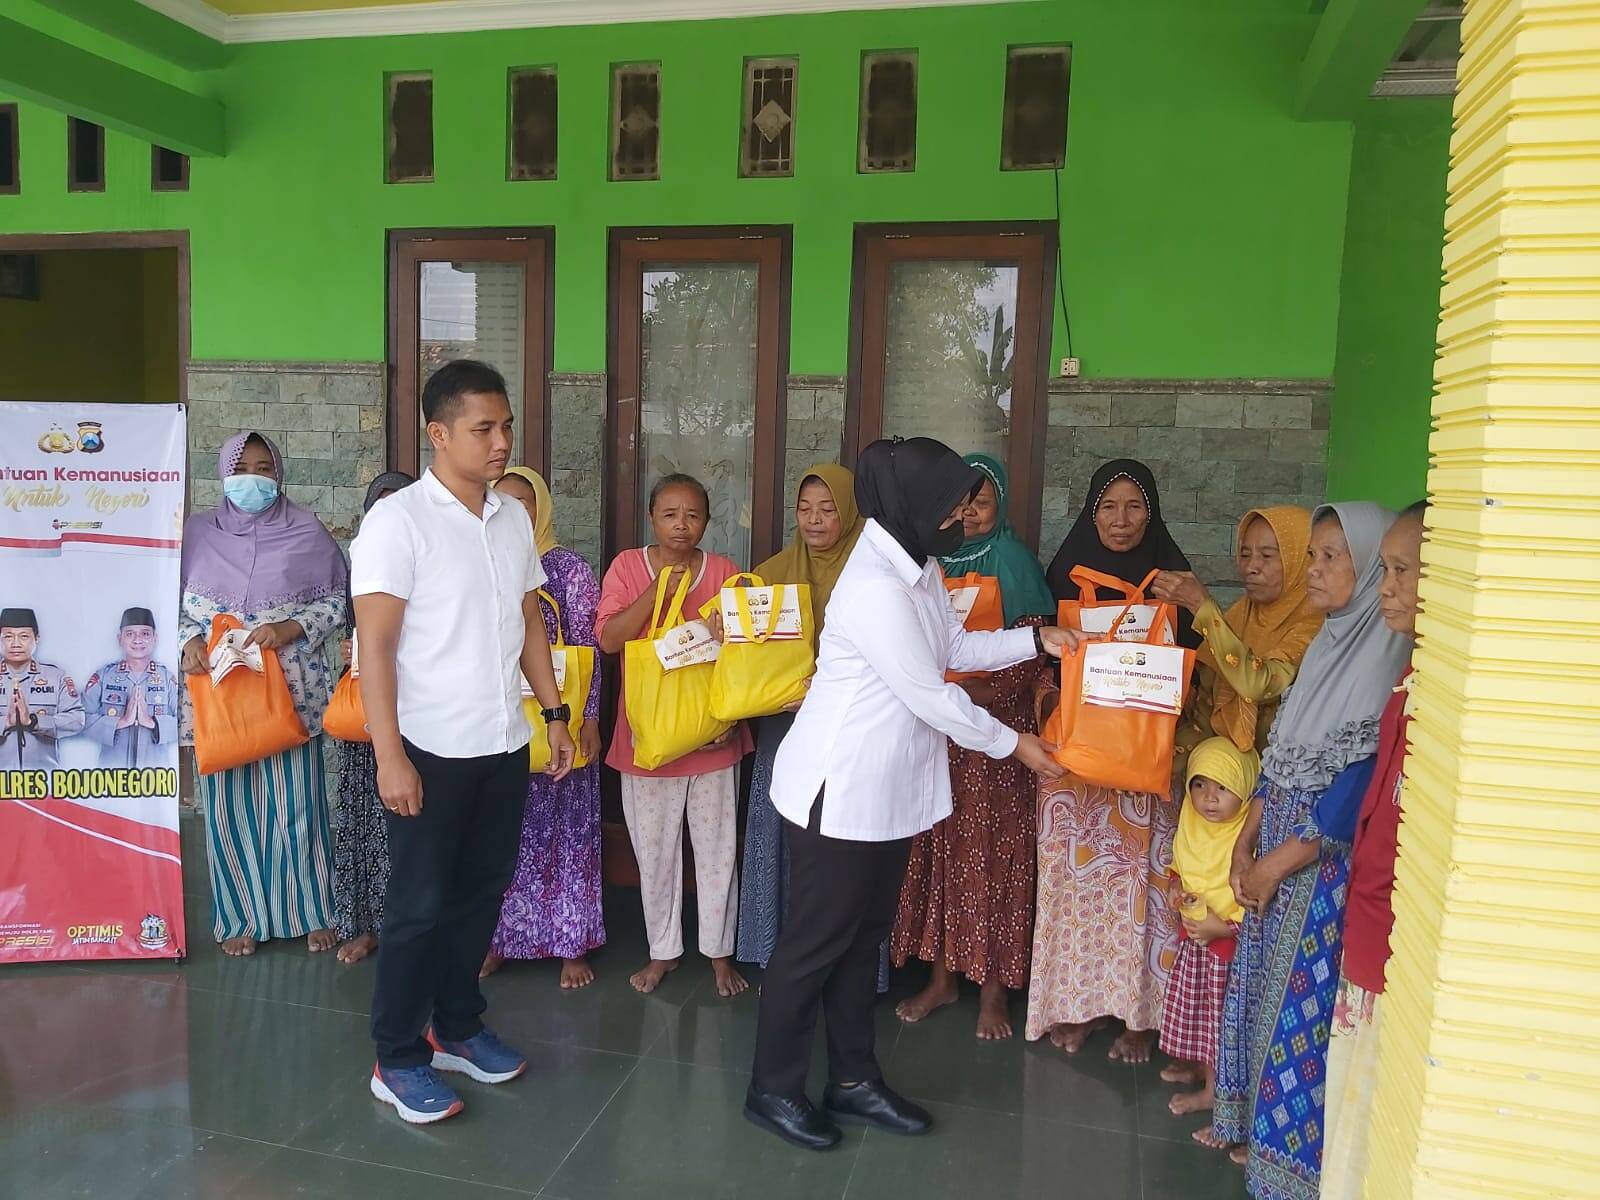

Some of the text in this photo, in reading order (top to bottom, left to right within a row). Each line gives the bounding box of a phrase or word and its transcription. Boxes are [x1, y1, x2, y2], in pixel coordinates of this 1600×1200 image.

[54, 467, 180, 482] Kemanusiaan
[84, 484, 150, 515] Negeri
[1090, 666, 1177, 682] Bantuan Kemanusiaan
[53, 768, 177, 798] BOJONEGORO
[67, 925, 124, 938] OPTIMIS
